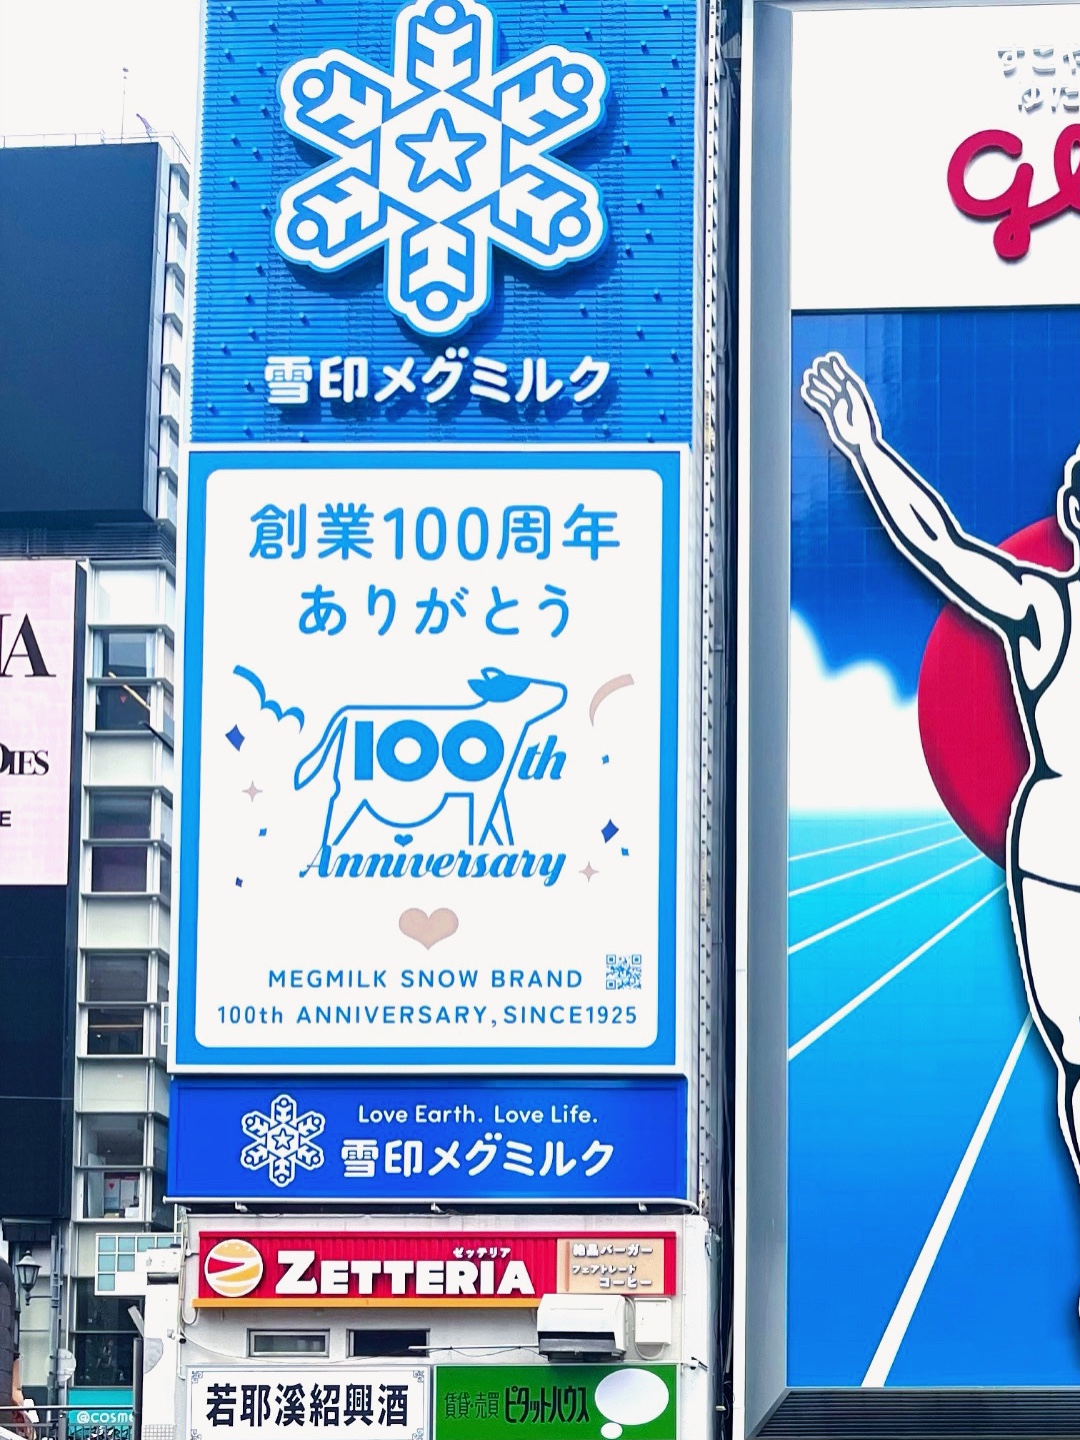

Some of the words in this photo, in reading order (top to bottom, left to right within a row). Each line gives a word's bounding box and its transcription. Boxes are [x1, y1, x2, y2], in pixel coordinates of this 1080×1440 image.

[264, 347, 611, 405] 雪印メグミルク
[248, 503, 621, 562] 創業100周年
[298, 584, 573, 637] ありがとう
[0, 613, 56, 677] A
[299, 845, 567, 887] Anniversary
[269, 969, 387, 988] MEGMILK
[401, 969, 477, 988] SNOW
[492, 969, 582, 988] BRAND
[217, 1004, 283, 1025] 100th
[359, 1104, 407, 1124] Love
[416, 1104, 483, 1124] Earth.
[494, 1104, 543, 1124] Love
[550, 1104, 598, 1124] Life.
[341, 1132, 614, 1178] 雪印メグミルク
[275, 1250, 535, 1294] ZETTERIA
[452, 1246, 512, 1259] ゼッテリア
[572, 1264, 637, 1275] フェアトレード
[600, 1277, 652, 1288] コーヒー
[505, 1385, 590, 1424] ピタットハウス
